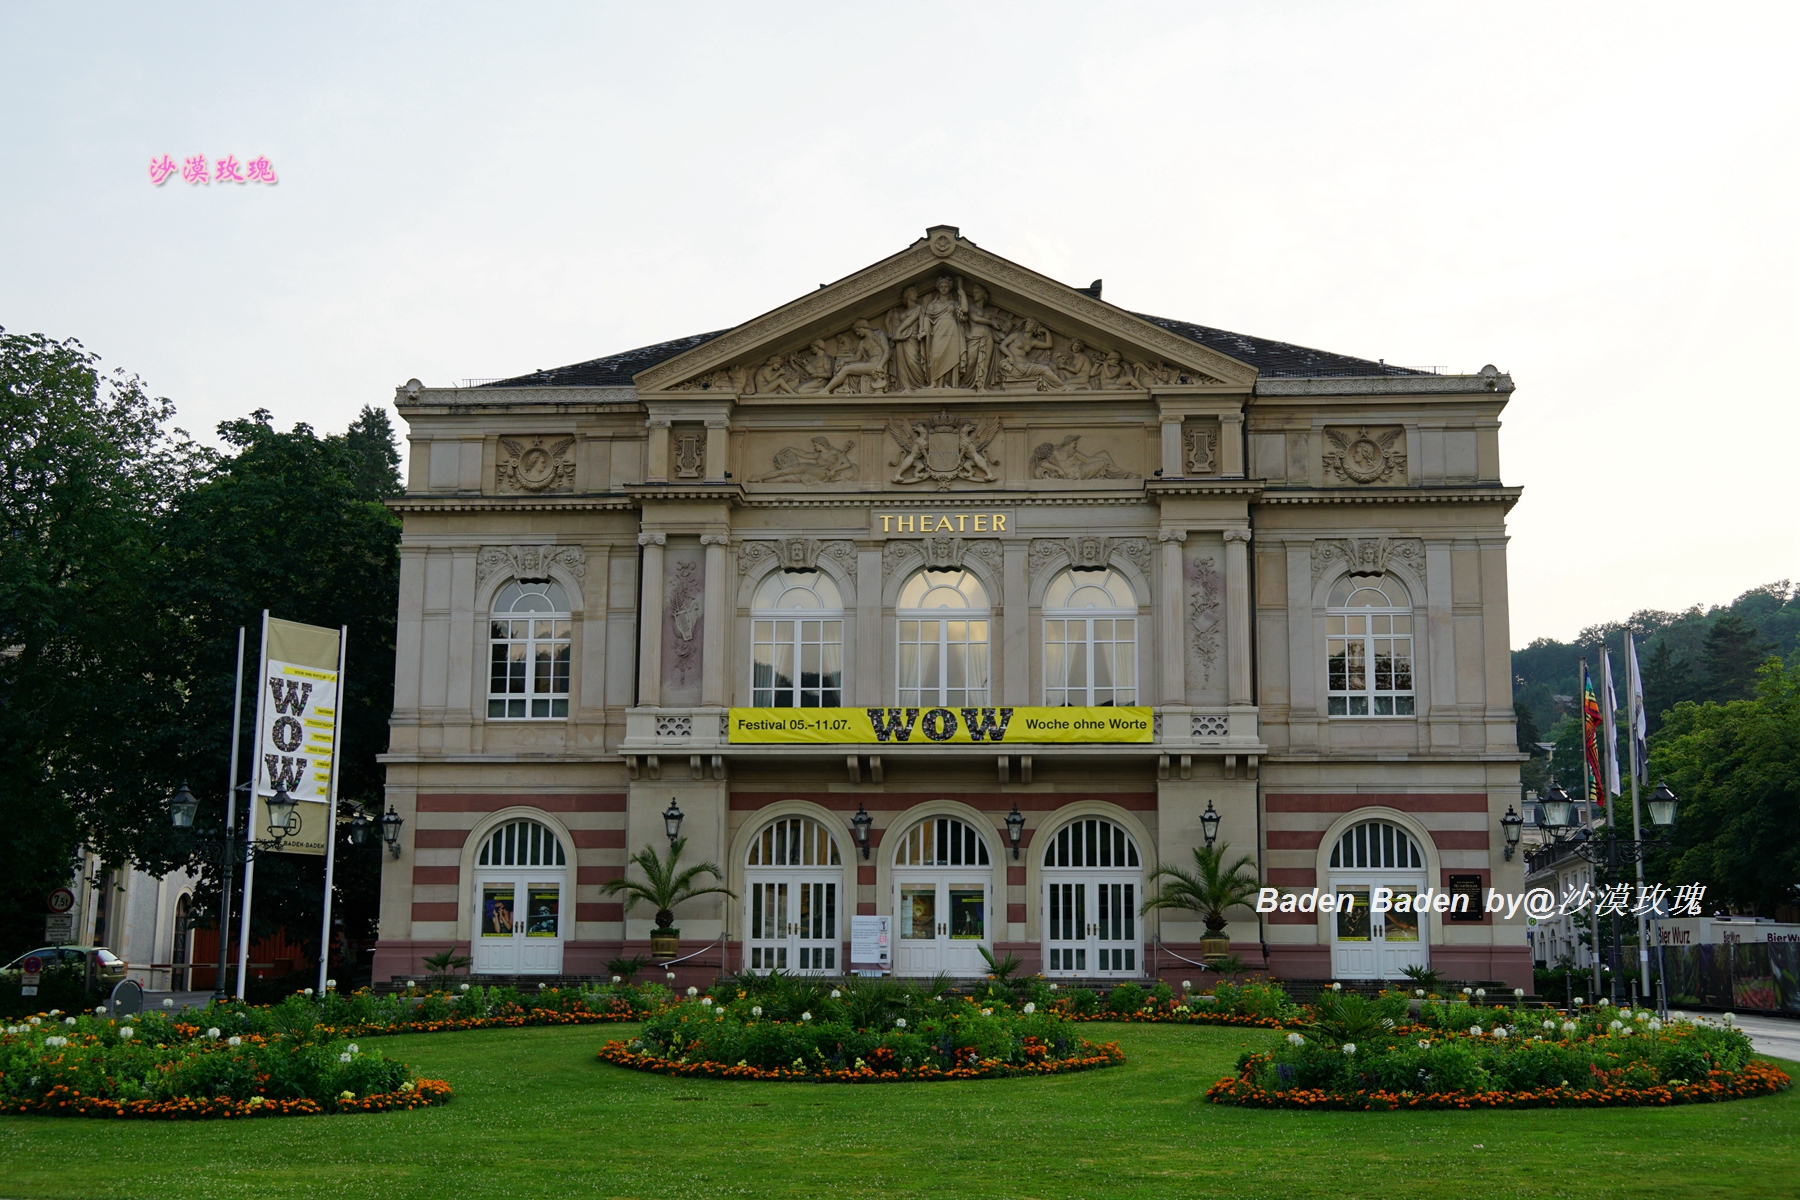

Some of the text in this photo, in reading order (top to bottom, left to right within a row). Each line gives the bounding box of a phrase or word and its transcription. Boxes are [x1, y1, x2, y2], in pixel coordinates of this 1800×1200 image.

[879, 514, 1007, 532] THEATER
[264, 676, 312, 792] WOW
[738, 719, 786, 730] Festival
[867, 708, 1013, 742] WOW
[1026, 718, 1070, 730] Woche
[1073, 718, 1105, 730] ohne
[1109, 718, 1148, 730] Worte
[54, 895, 69, 907] 7,5t
[1657, 926, 1691, 944] Bier Wurz
